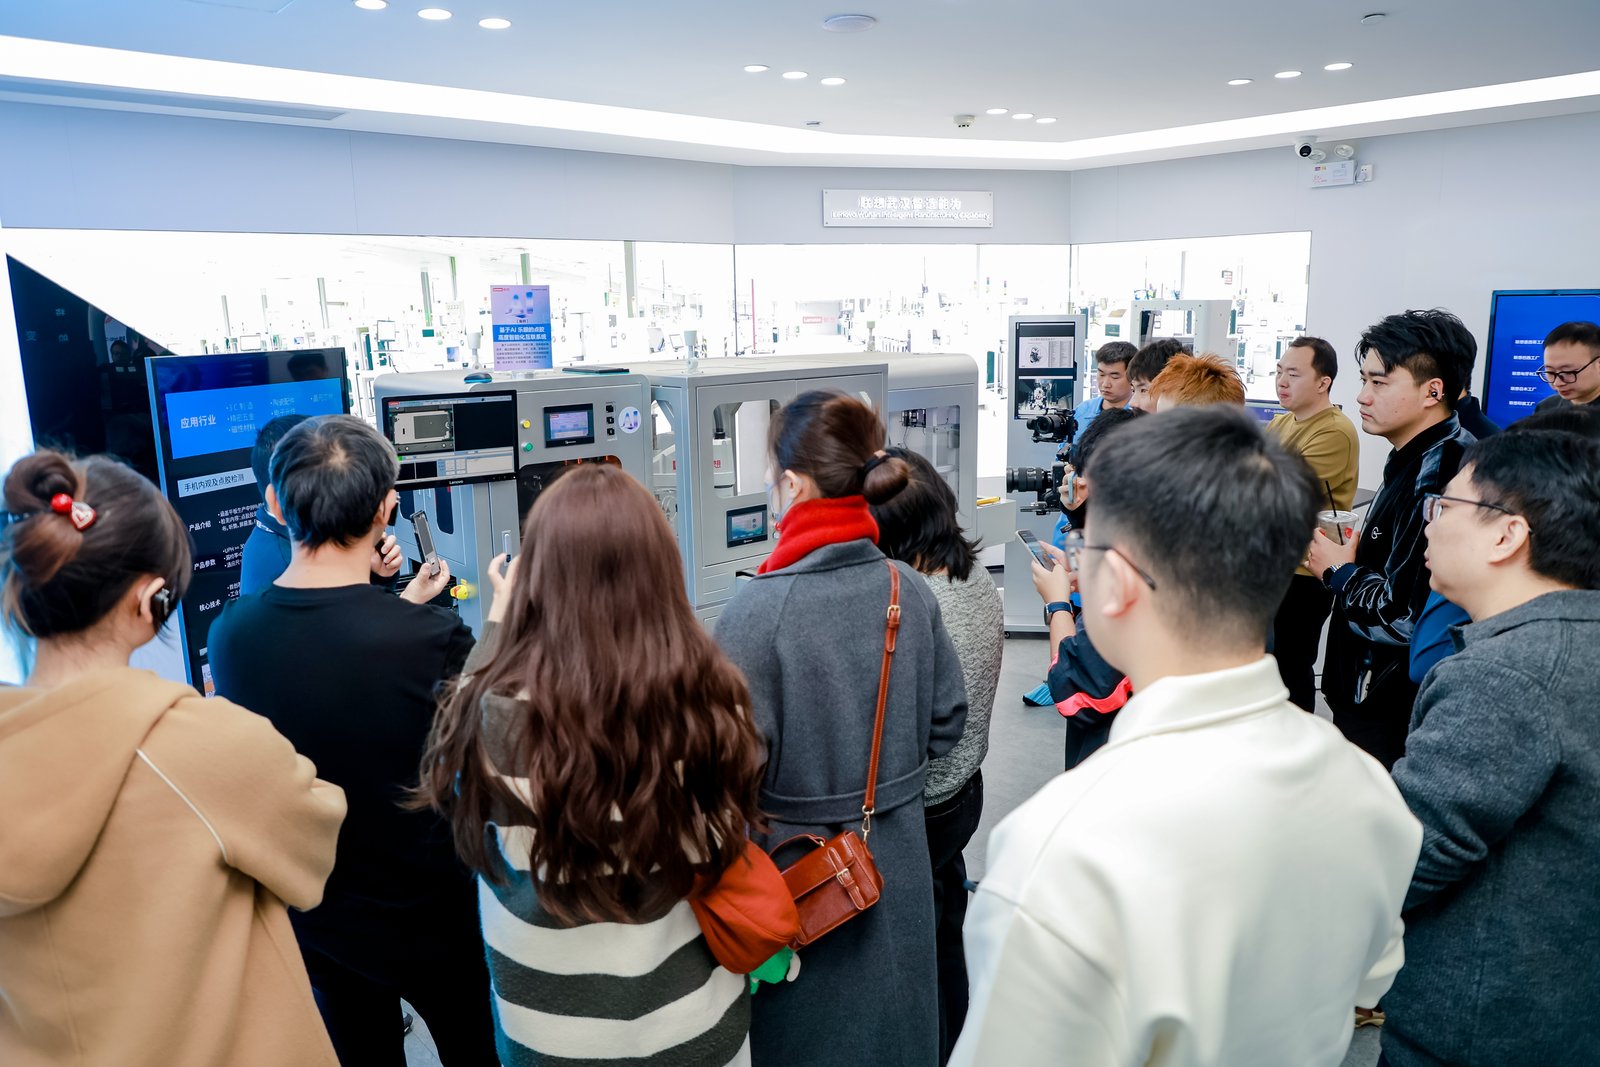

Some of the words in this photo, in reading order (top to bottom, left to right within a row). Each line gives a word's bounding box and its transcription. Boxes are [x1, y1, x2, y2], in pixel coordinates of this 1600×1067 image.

[180, 414, 217, 429] 应用行业
[188, 520, 212, 532] 产品介绍
[193, 558, 216, 571] 产品参数
[199, 599, 221, 612] 核心技术
